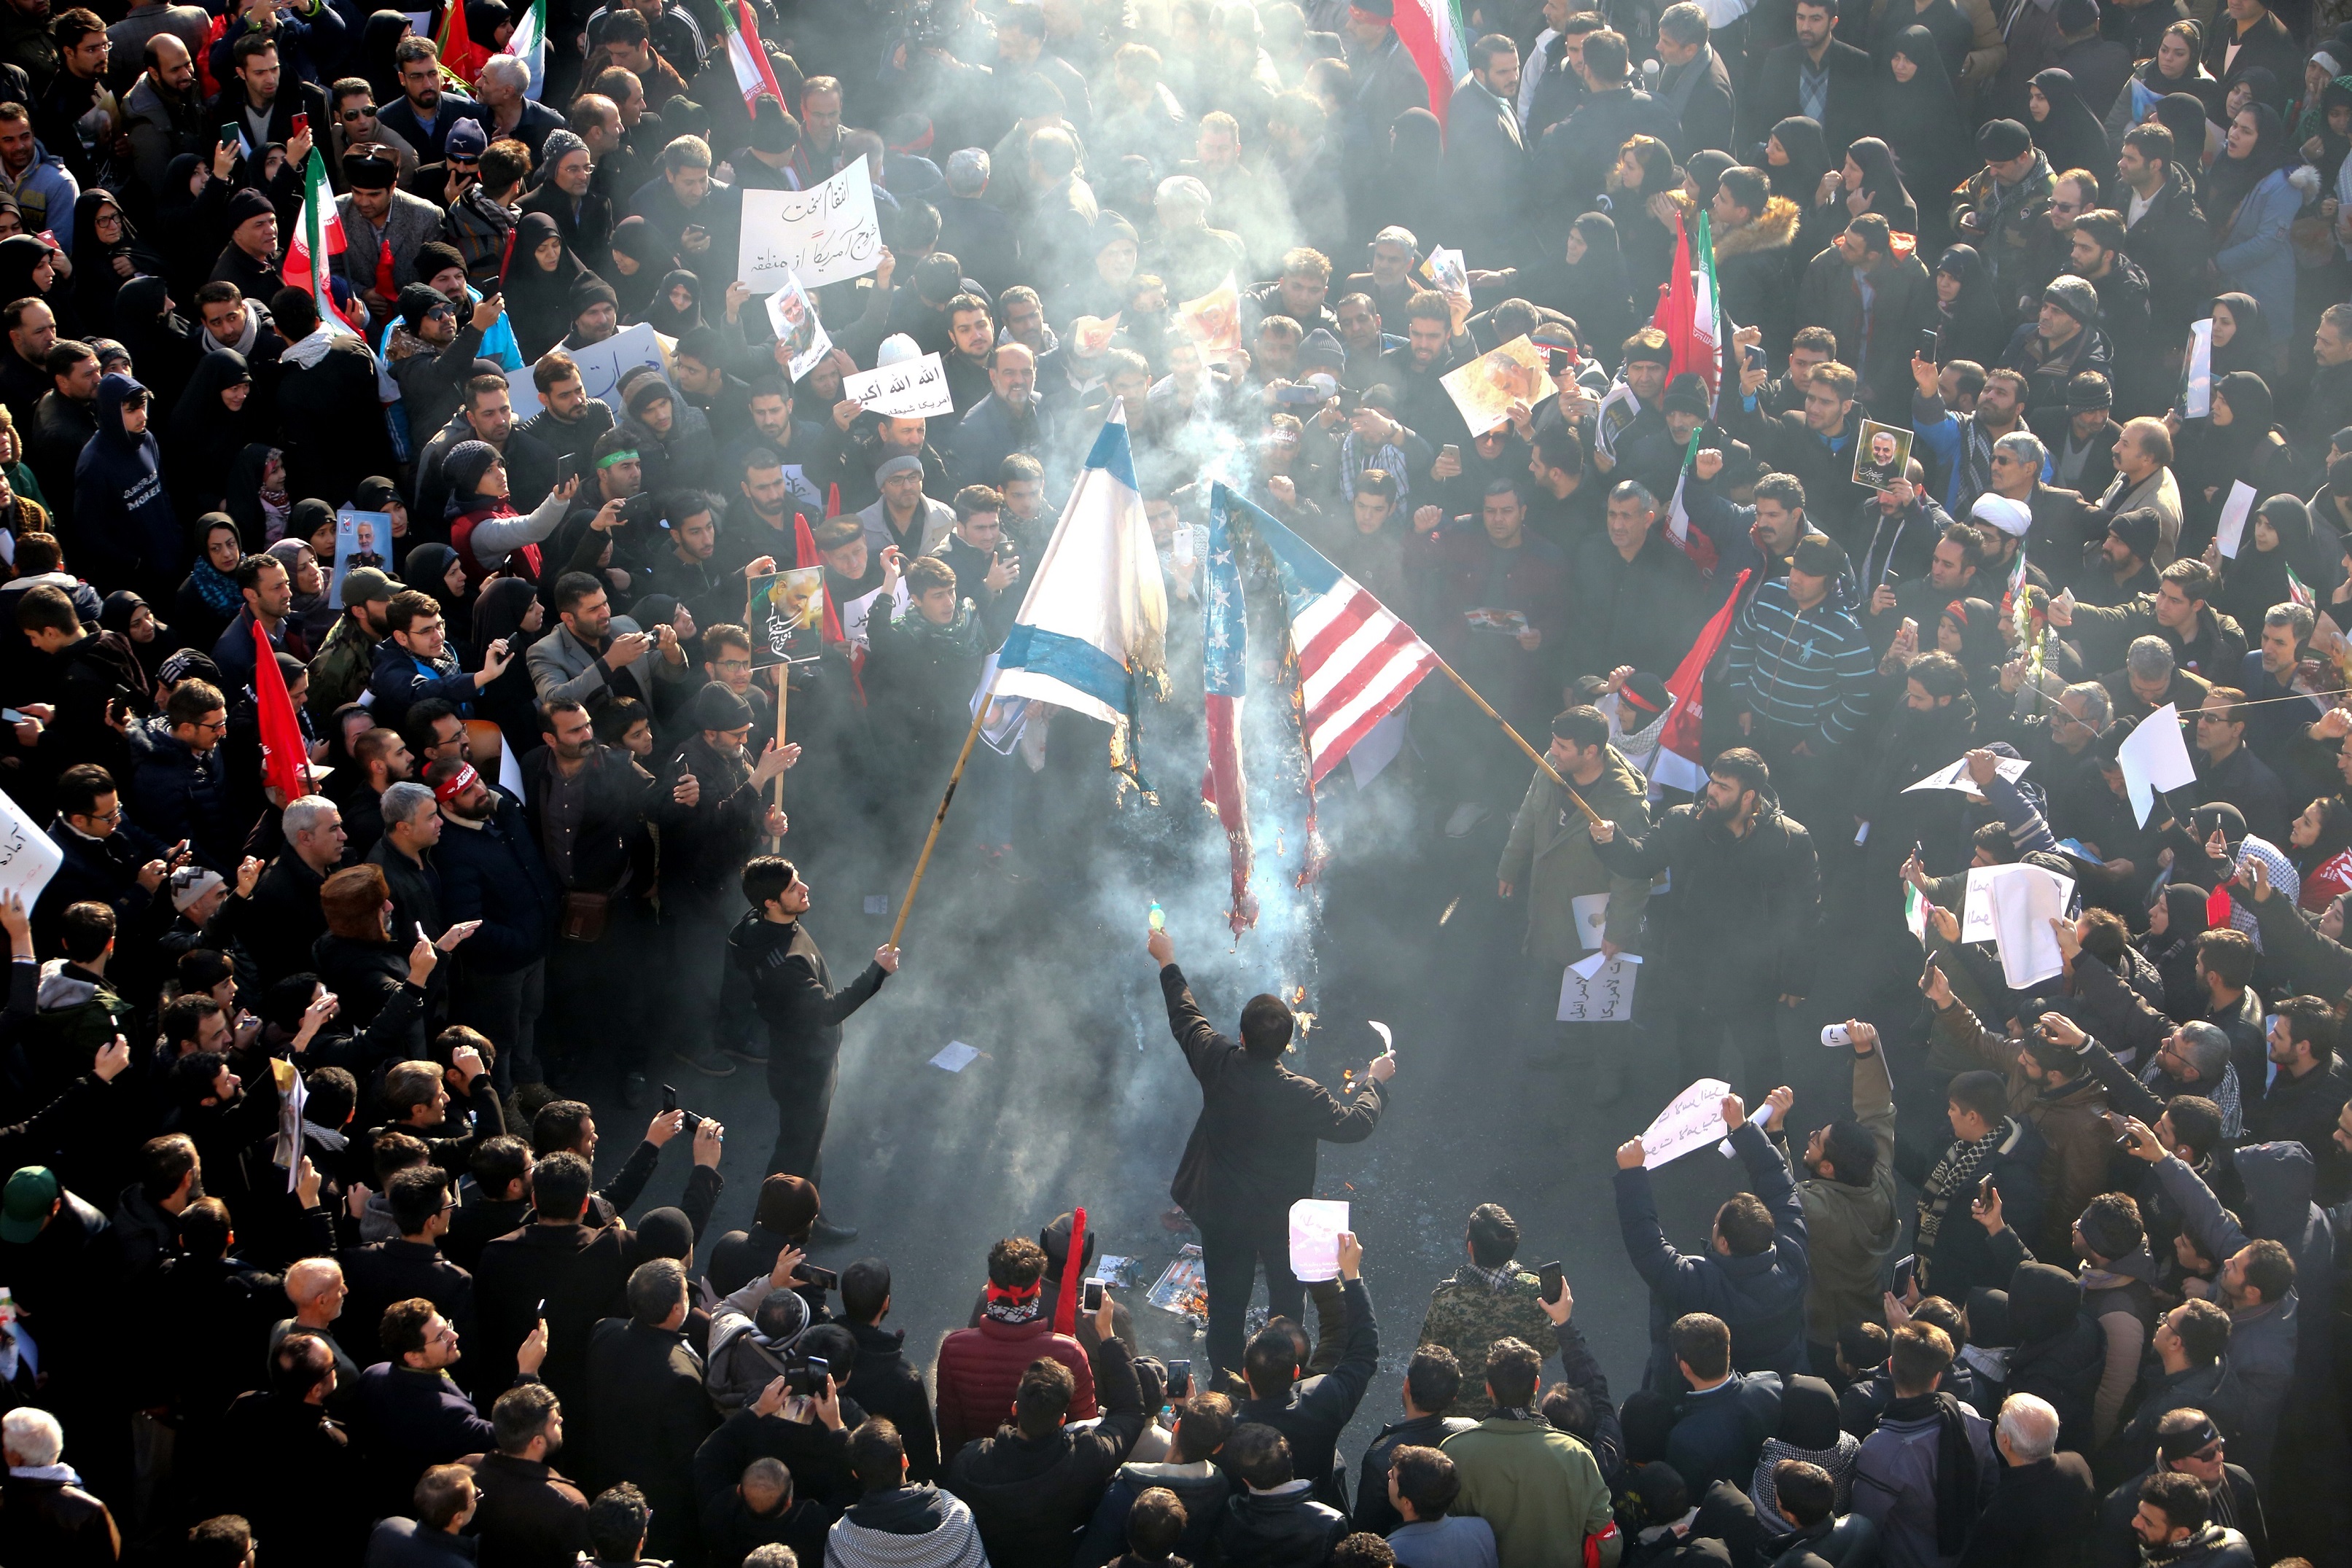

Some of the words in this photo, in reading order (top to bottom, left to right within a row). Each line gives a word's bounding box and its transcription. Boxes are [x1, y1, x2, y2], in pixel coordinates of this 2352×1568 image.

[782, 193, 822, 222] سخت
[824, 172, 849, 220] انتقام
[850, 224, 877, 261] خروج
[751, 247, 788, 273] منطقه
[792, 248, 805, 271] از
[889, 374, 911, 394] الله
[919, 365, 940, 385] الله
